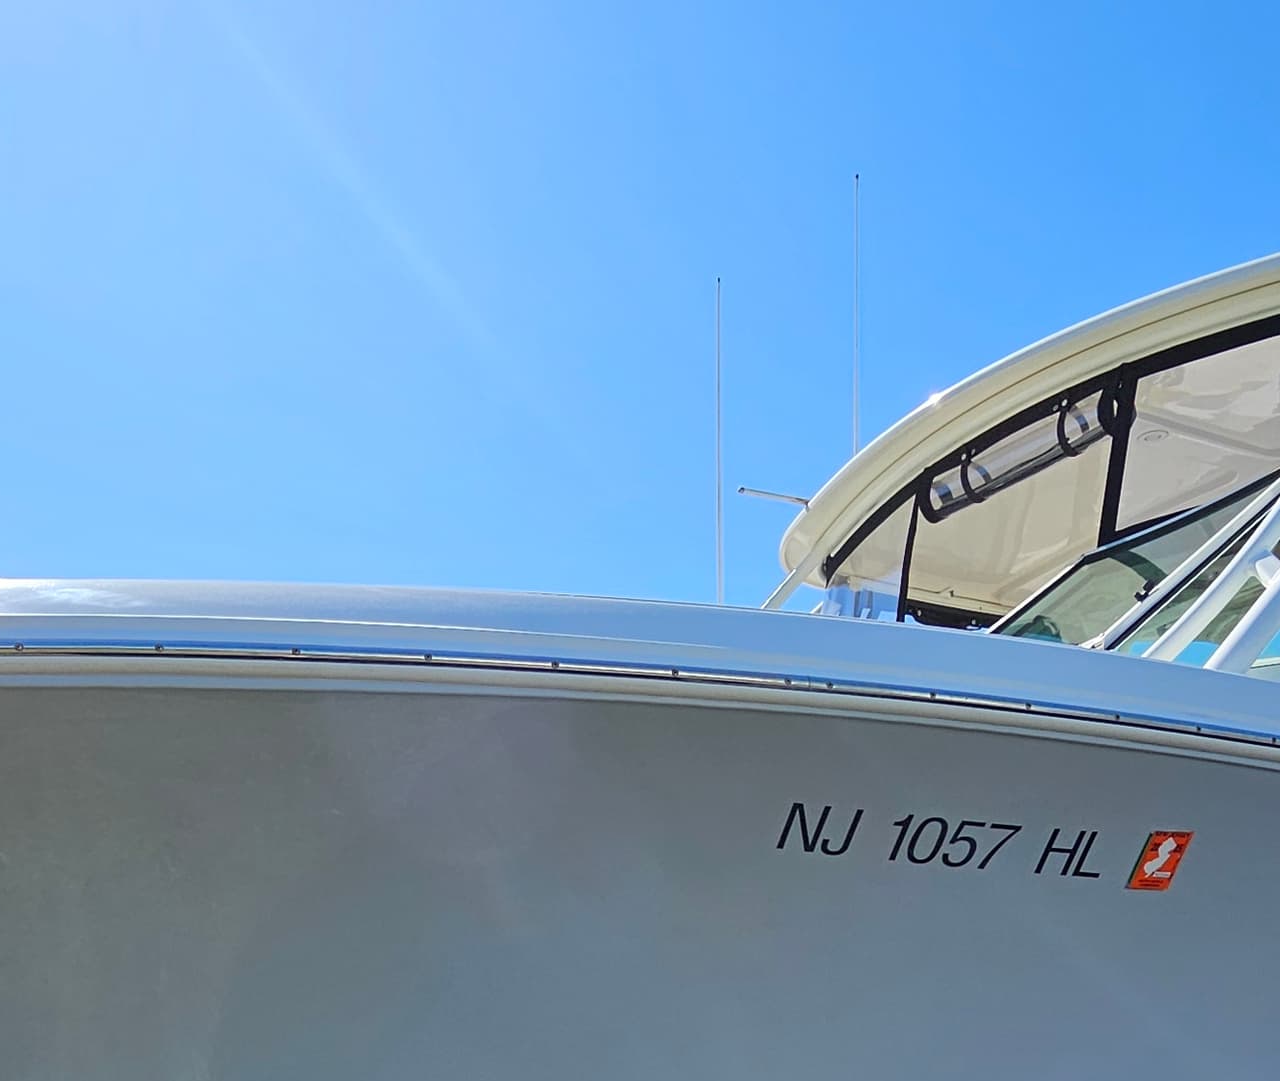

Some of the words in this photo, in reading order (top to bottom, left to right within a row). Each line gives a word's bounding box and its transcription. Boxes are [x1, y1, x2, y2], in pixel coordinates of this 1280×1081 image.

[776, 802, 863, 855] NJ
[888, 814, 1022, 870] 1057
[1034, 828, 1102, 878] HL
